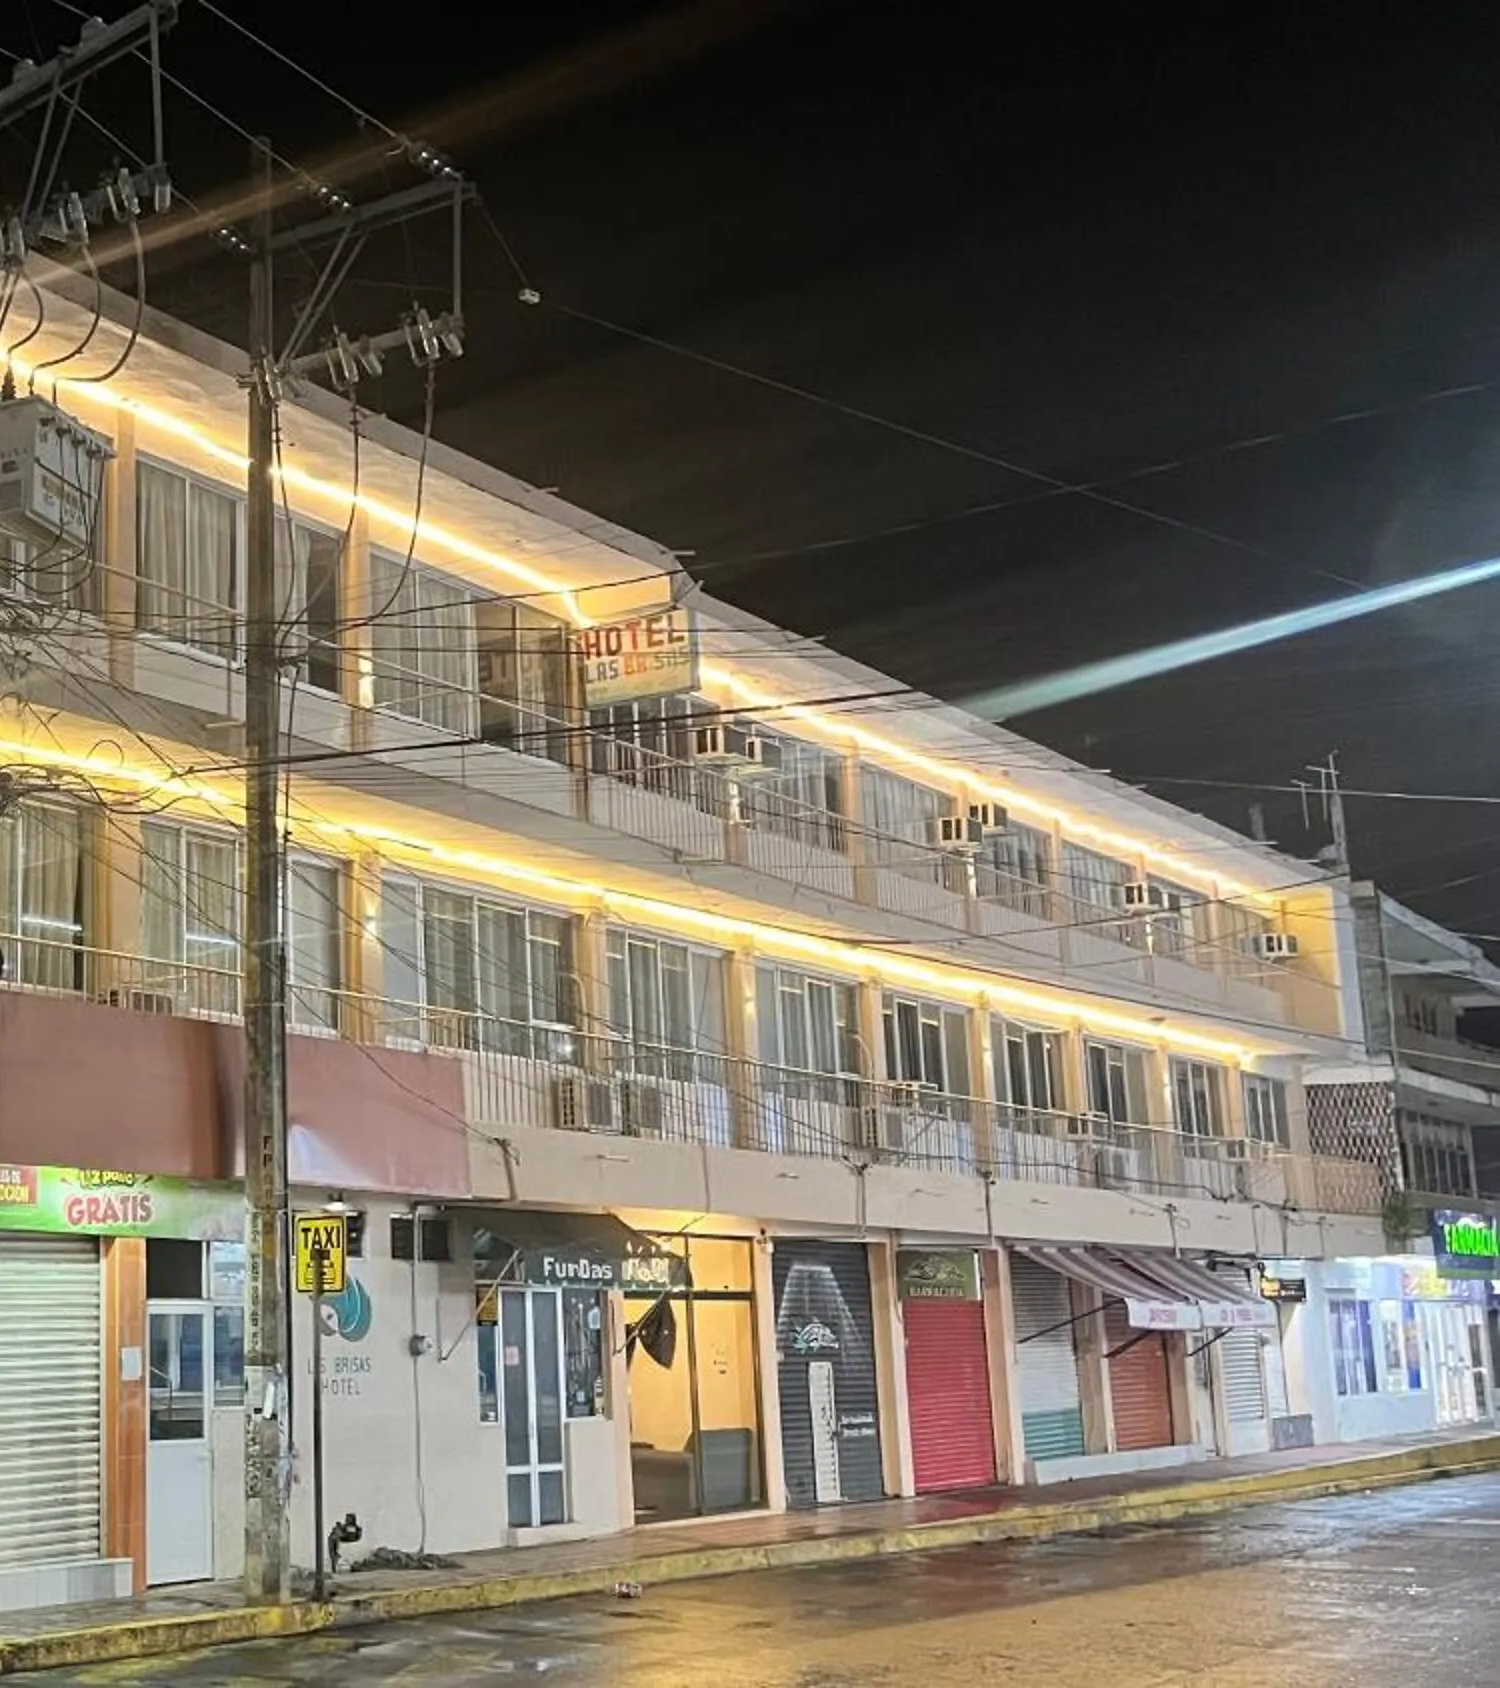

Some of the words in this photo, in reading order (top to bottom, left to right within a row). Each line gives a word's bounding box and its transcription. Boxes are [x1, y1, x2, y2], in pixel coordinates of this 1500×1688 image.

[580, 613, 686, 660] HOTEL
[584, 659, 619, 684] LAS
[66, 1193, 153, 1226] GRATIS
[301, 1226, 341, 1250] TAXI
[307, 1357, 327, 1375] LS
[334, 1355, 372, 1373] BRISAS
